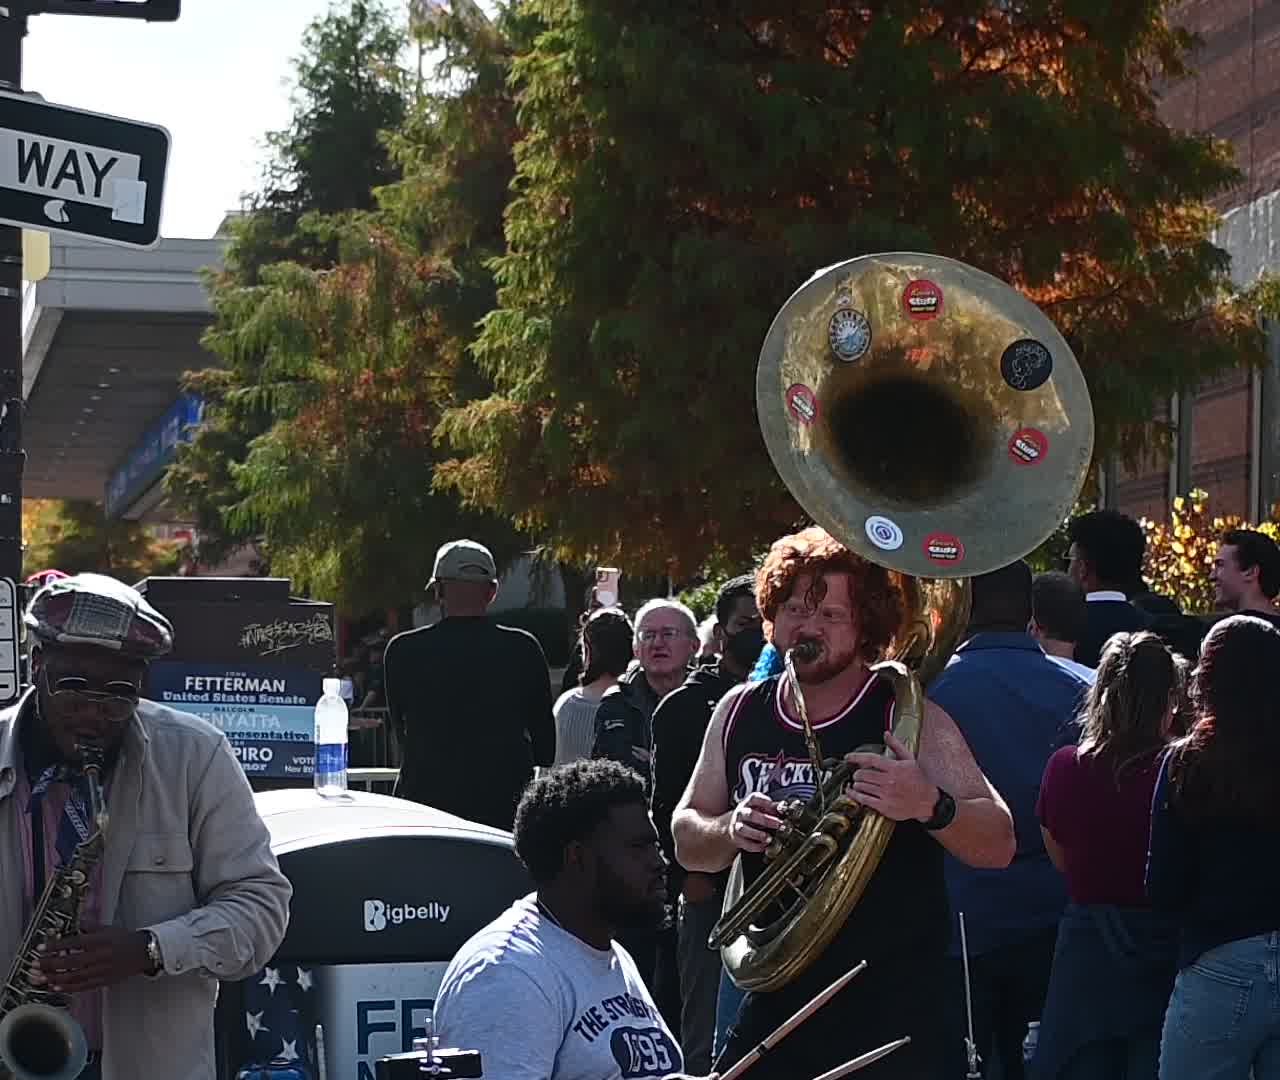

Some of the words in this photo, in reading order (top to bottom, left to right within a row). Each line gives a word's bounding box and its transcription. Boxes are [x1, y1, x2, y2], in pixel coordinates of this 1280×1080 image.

[17, 137, 118, 198] WAY
[162, 691, 209, 702] United
[212, 692, 256, 703] States
[258, 694, 307, 704] Senate
[184, 676, 286, 693] FETTERMAN
[363, 899, 450, 932] Bigbelly
[572, 1006, 610, 1043] THE
